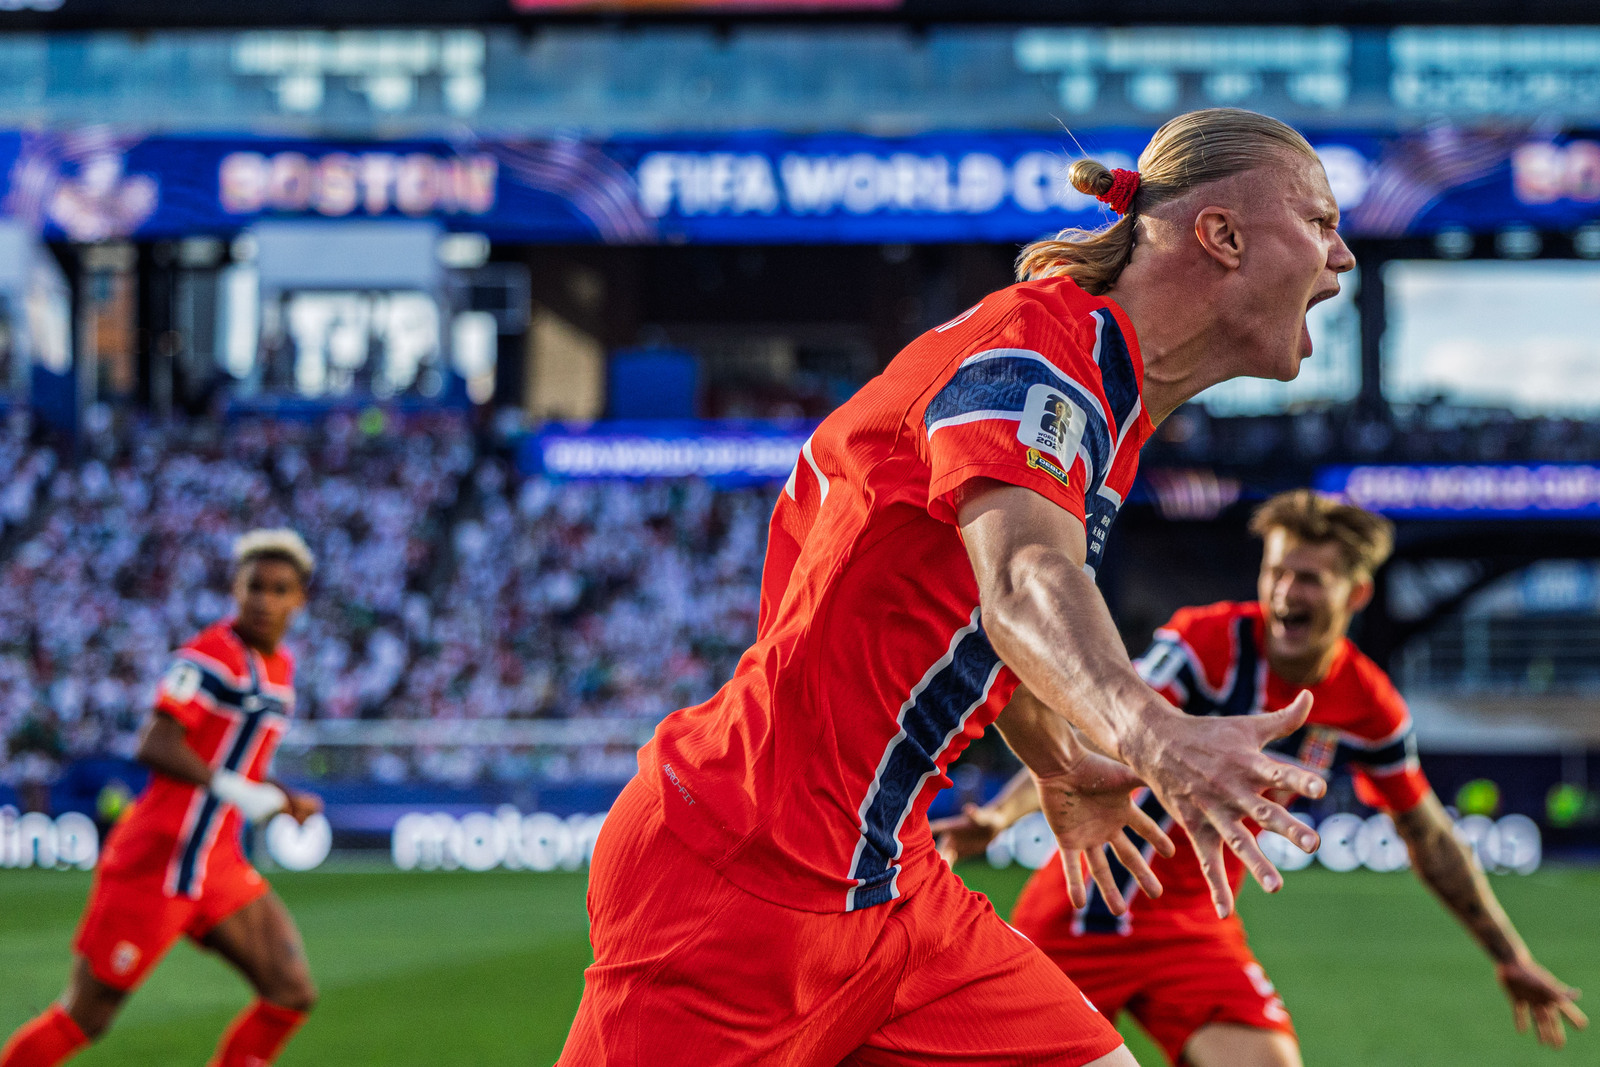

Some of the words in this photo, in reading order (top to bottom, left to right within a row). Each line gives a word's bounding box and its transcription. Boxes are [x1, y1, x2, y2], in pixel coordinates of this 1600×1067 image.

[220, 152, 497, 215] BOSTON
[638, 151, 779, 217] FIFA
[781, 151, 1003, 216] WORLD
[1038, 458, 1066, 478] DEBUT
[663, 763, 695, 805] AERO-FIT
